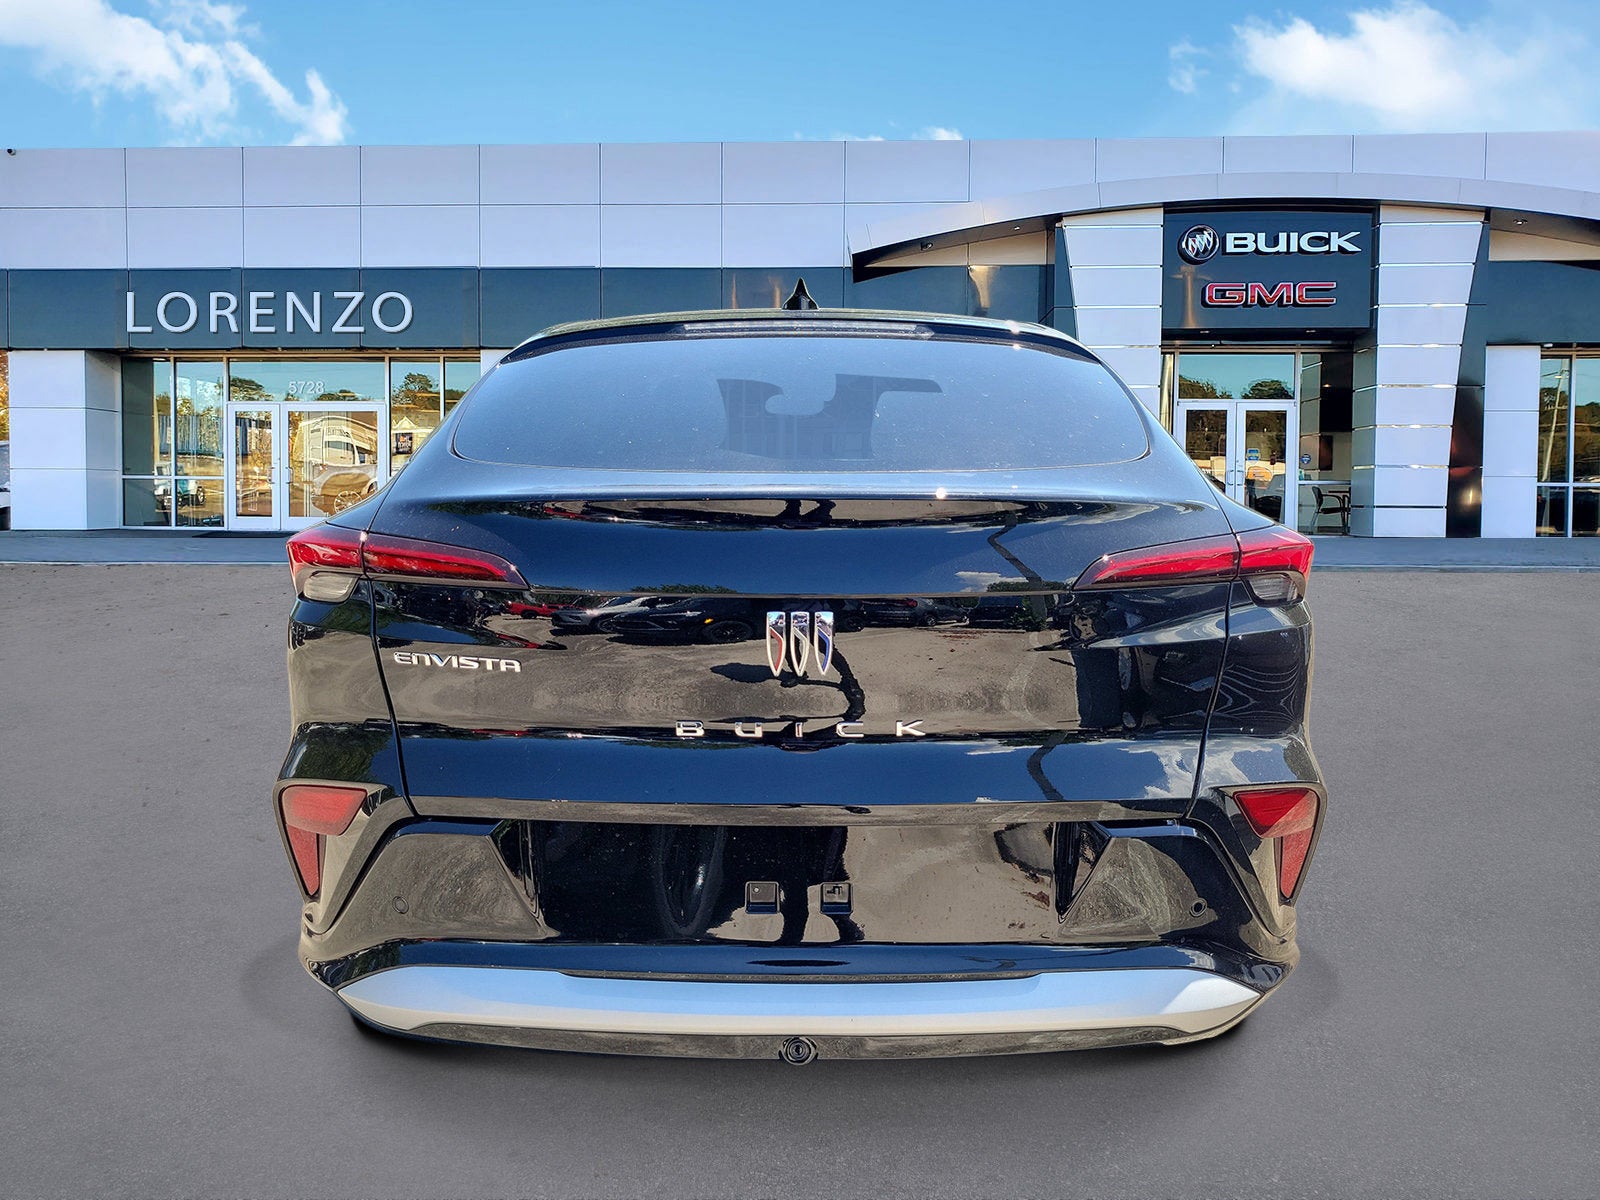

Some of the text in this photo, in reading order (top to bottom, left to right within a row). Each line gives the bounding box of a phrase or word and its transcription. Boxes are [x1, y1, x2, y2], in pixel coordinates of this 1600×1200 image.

[1225, 231, 1362, 253] BUICK
[1205, 281, 1337, 305] GMC
[126, 291, 413, 333] LORENZO
[288, 381, 325, 394] 5728
[393, 651, 521, 672] ENVISTA
[676, 719, 926, 738] BUICK
